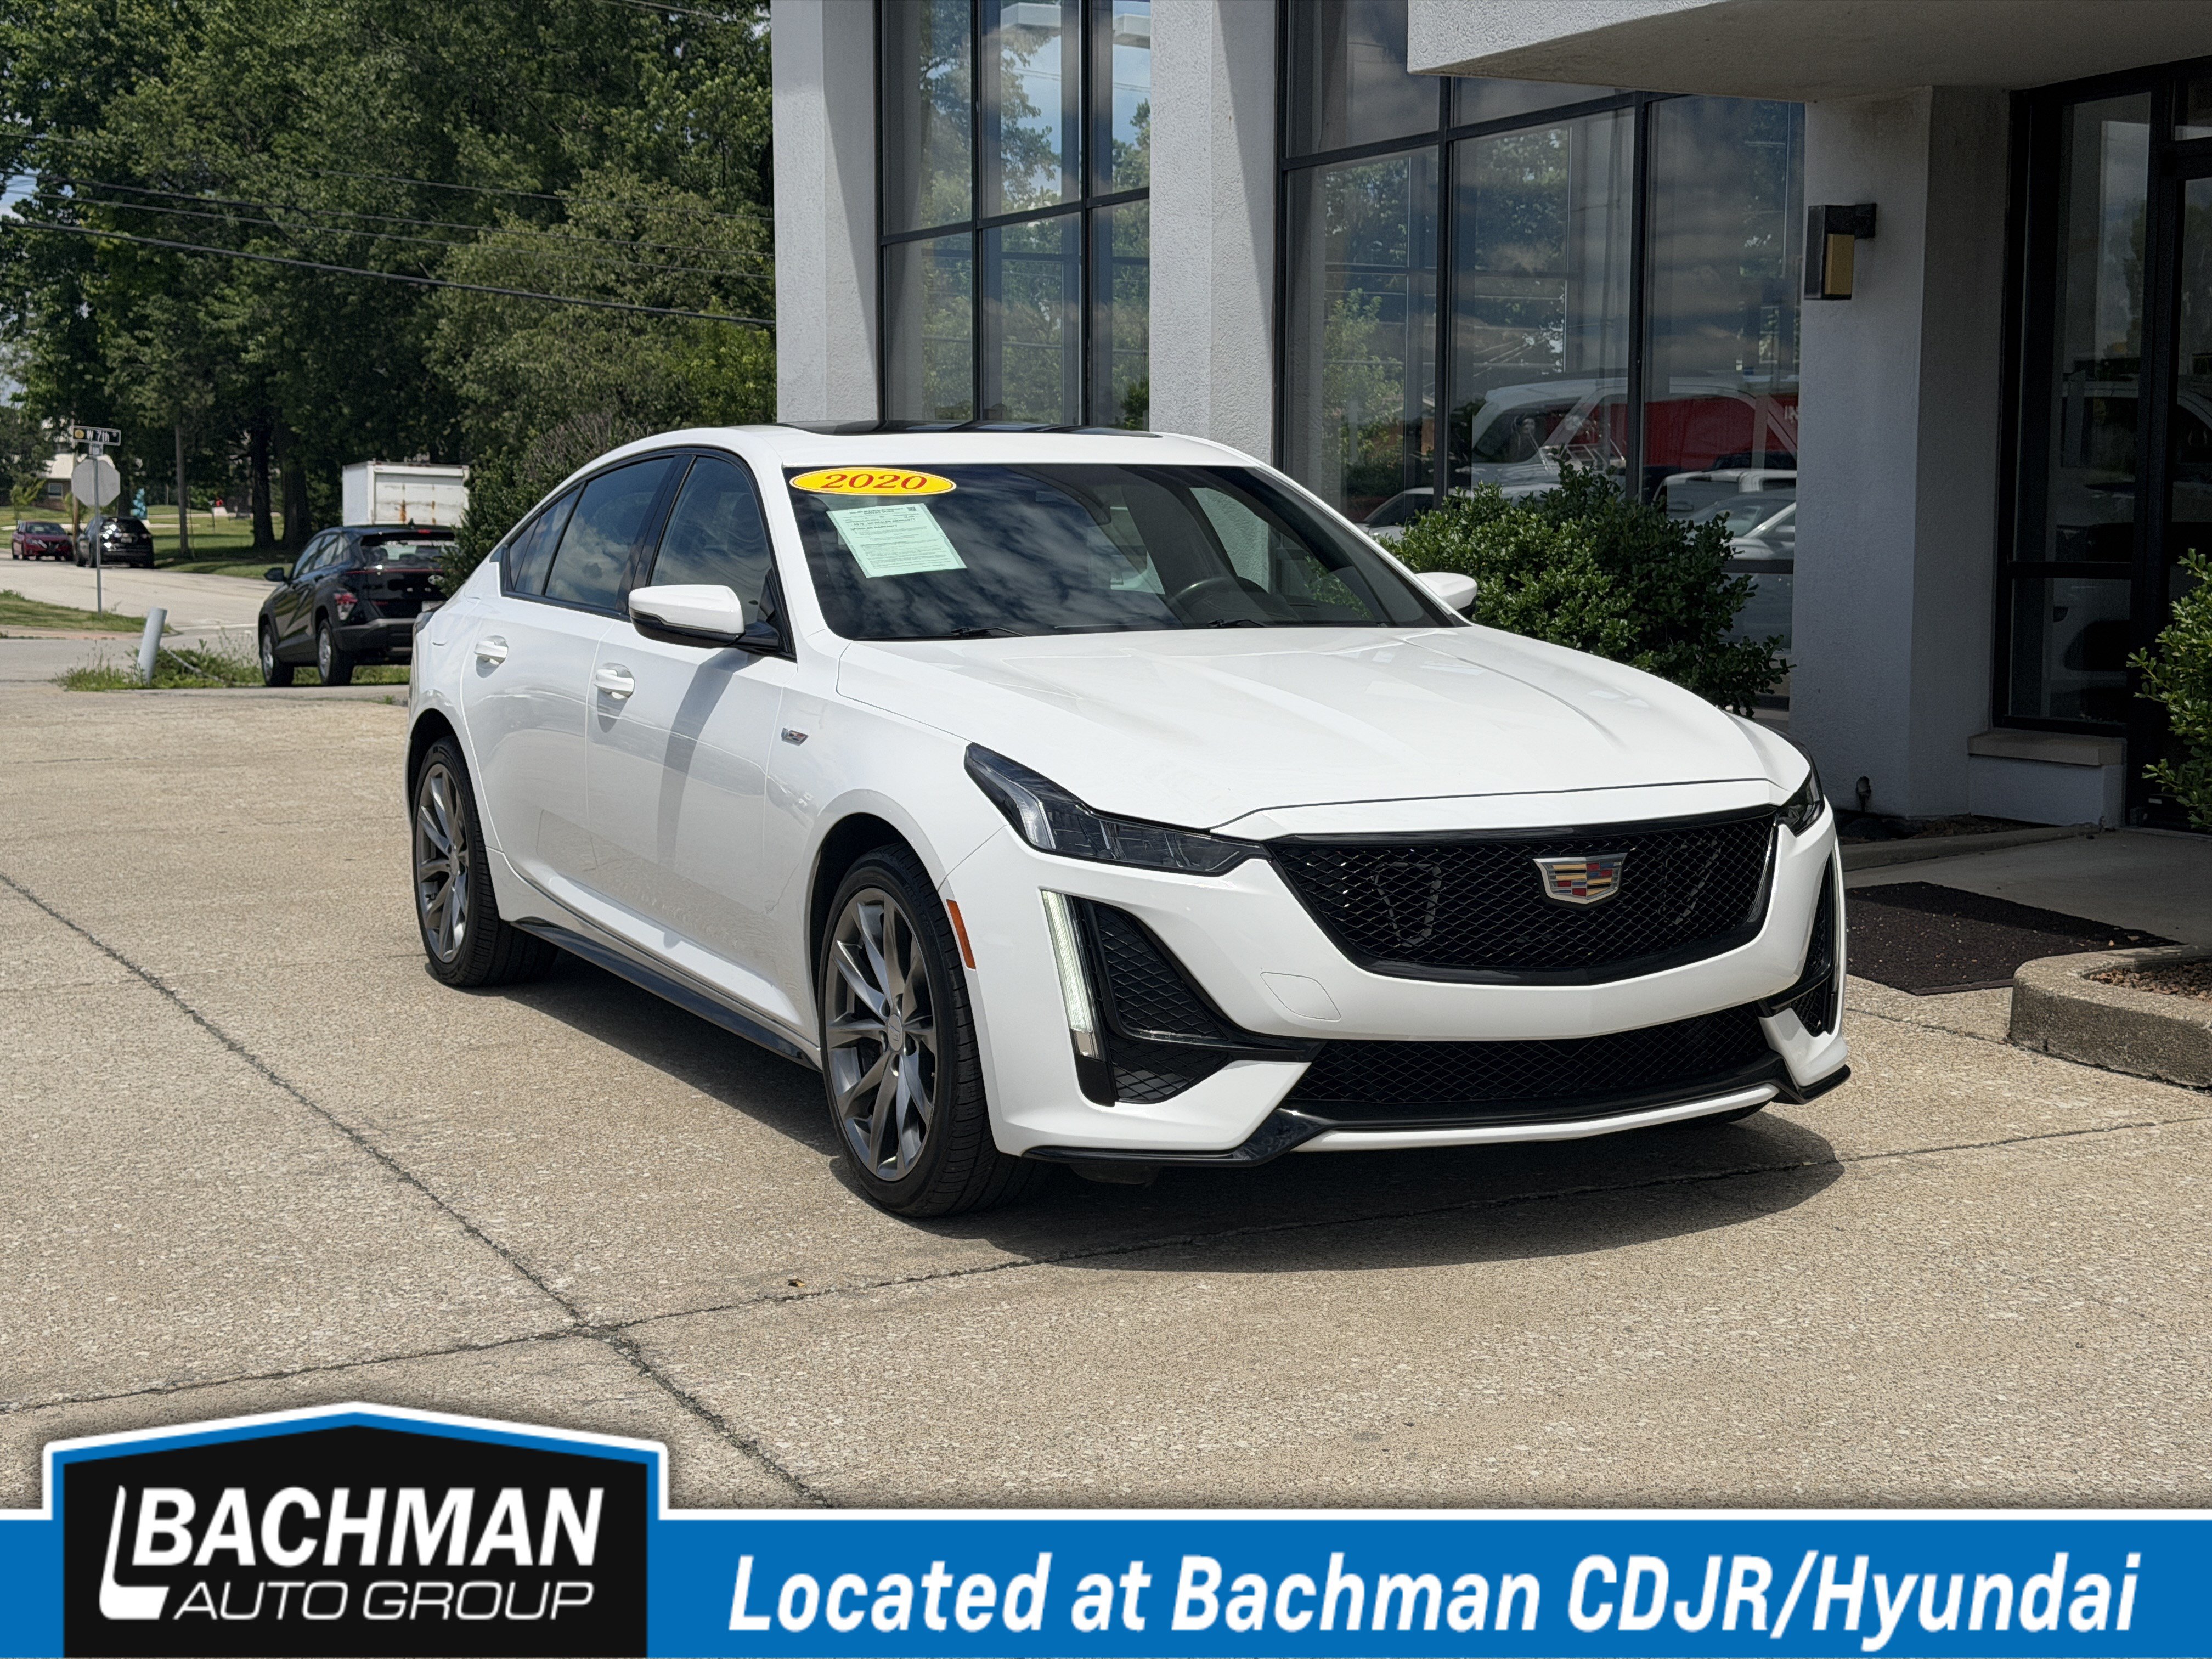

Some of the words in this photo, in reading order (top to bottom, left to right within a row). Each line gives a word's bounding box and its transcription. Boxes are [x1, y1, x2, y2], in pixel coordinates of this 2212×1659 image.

[87, 430, 94, 441] W
[97, 429, 110, 442] 7th
[820, 473, 927, 490] 2020
